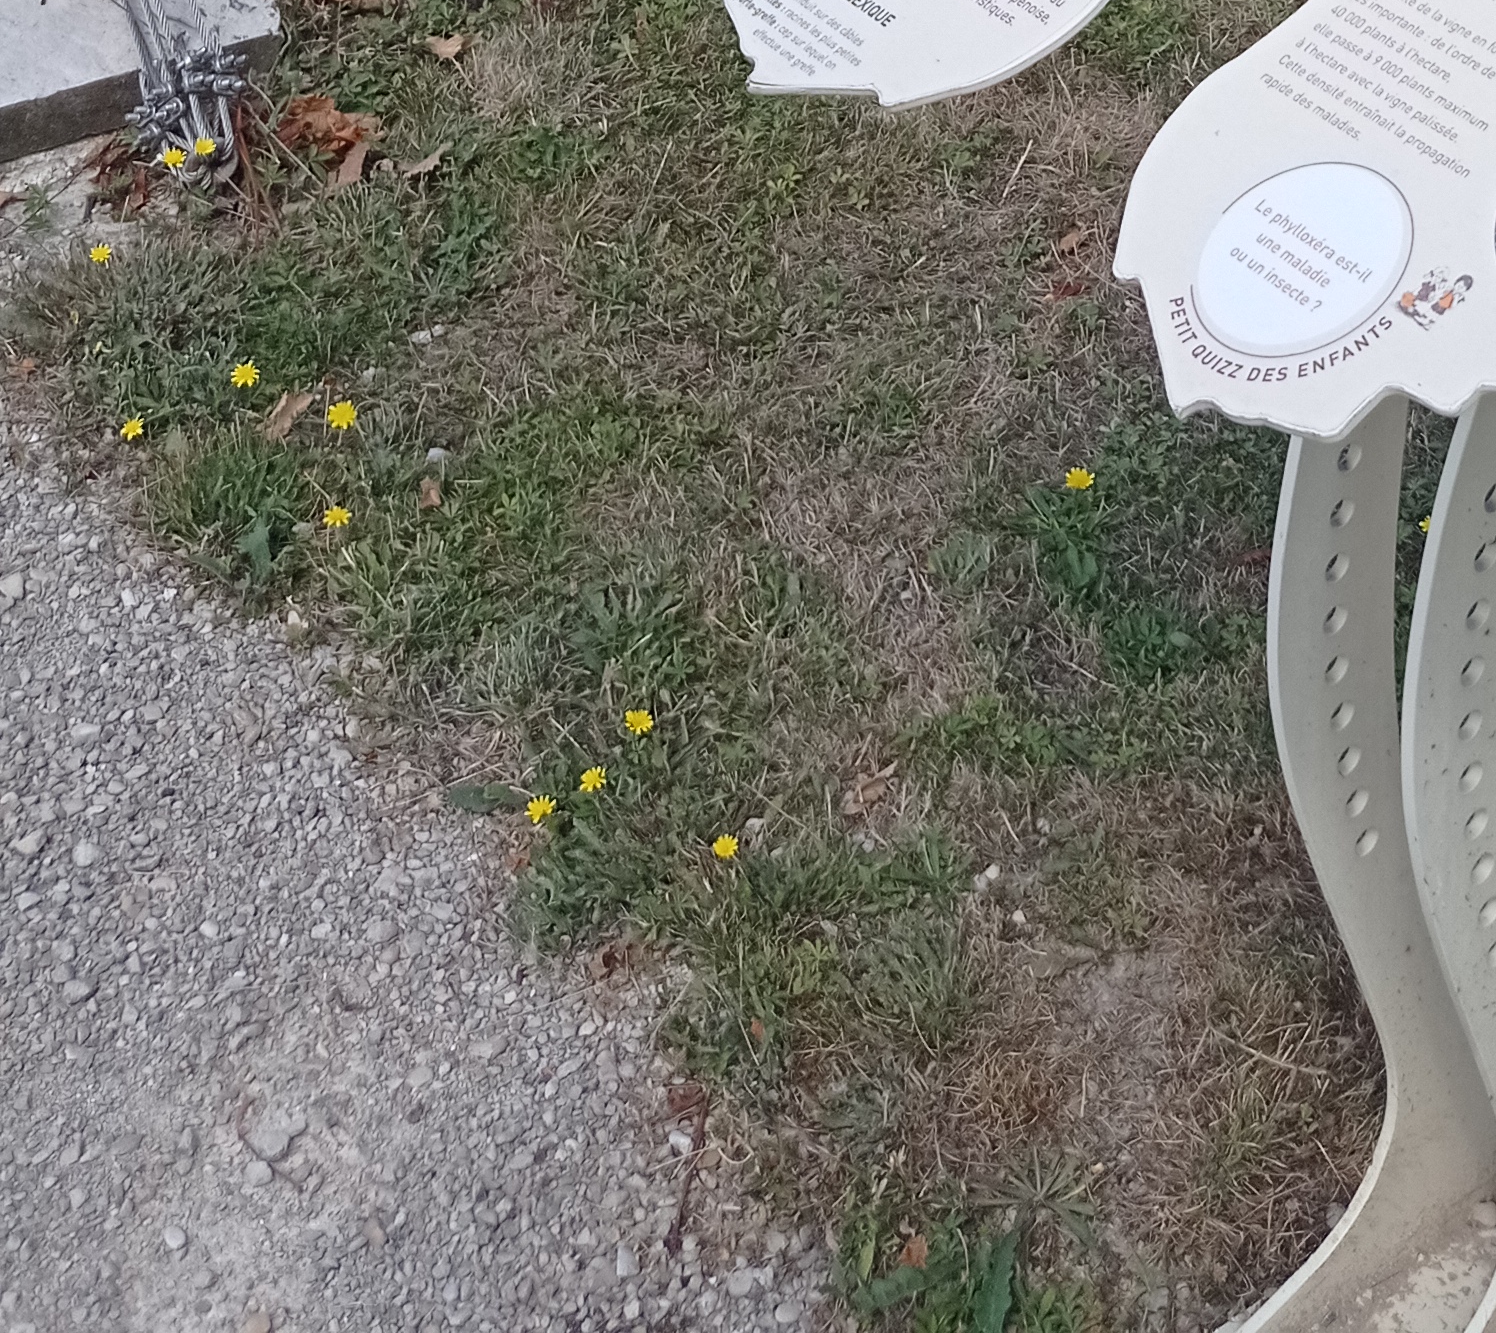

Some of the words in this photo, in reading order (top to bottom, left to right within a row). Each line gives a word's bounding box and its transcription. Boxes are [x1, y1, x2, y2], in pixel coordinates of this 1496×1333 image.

[1254, 198, 1273, 217] Le
[1268, 212, 1336, 260] phylloxéra
[1334, 255, 1373, 284] est-il
[1255, 232, 1282, 254] une
[1279, 249, 1331, 288] maladie
[1229, 247, 1249, 263] ou
[1246, 258, 1265, 275] un
[1263, 267, 1310, 306] insecte
[1309, 299, 1323, 312] ?
[1169, 296, 1198, 344] PETIT
[1191, 344, 1244, 379] QUIZZ
[1246, 366, 1289, 383] DES
[1298, 315, 1394, 379] ENFANTS
